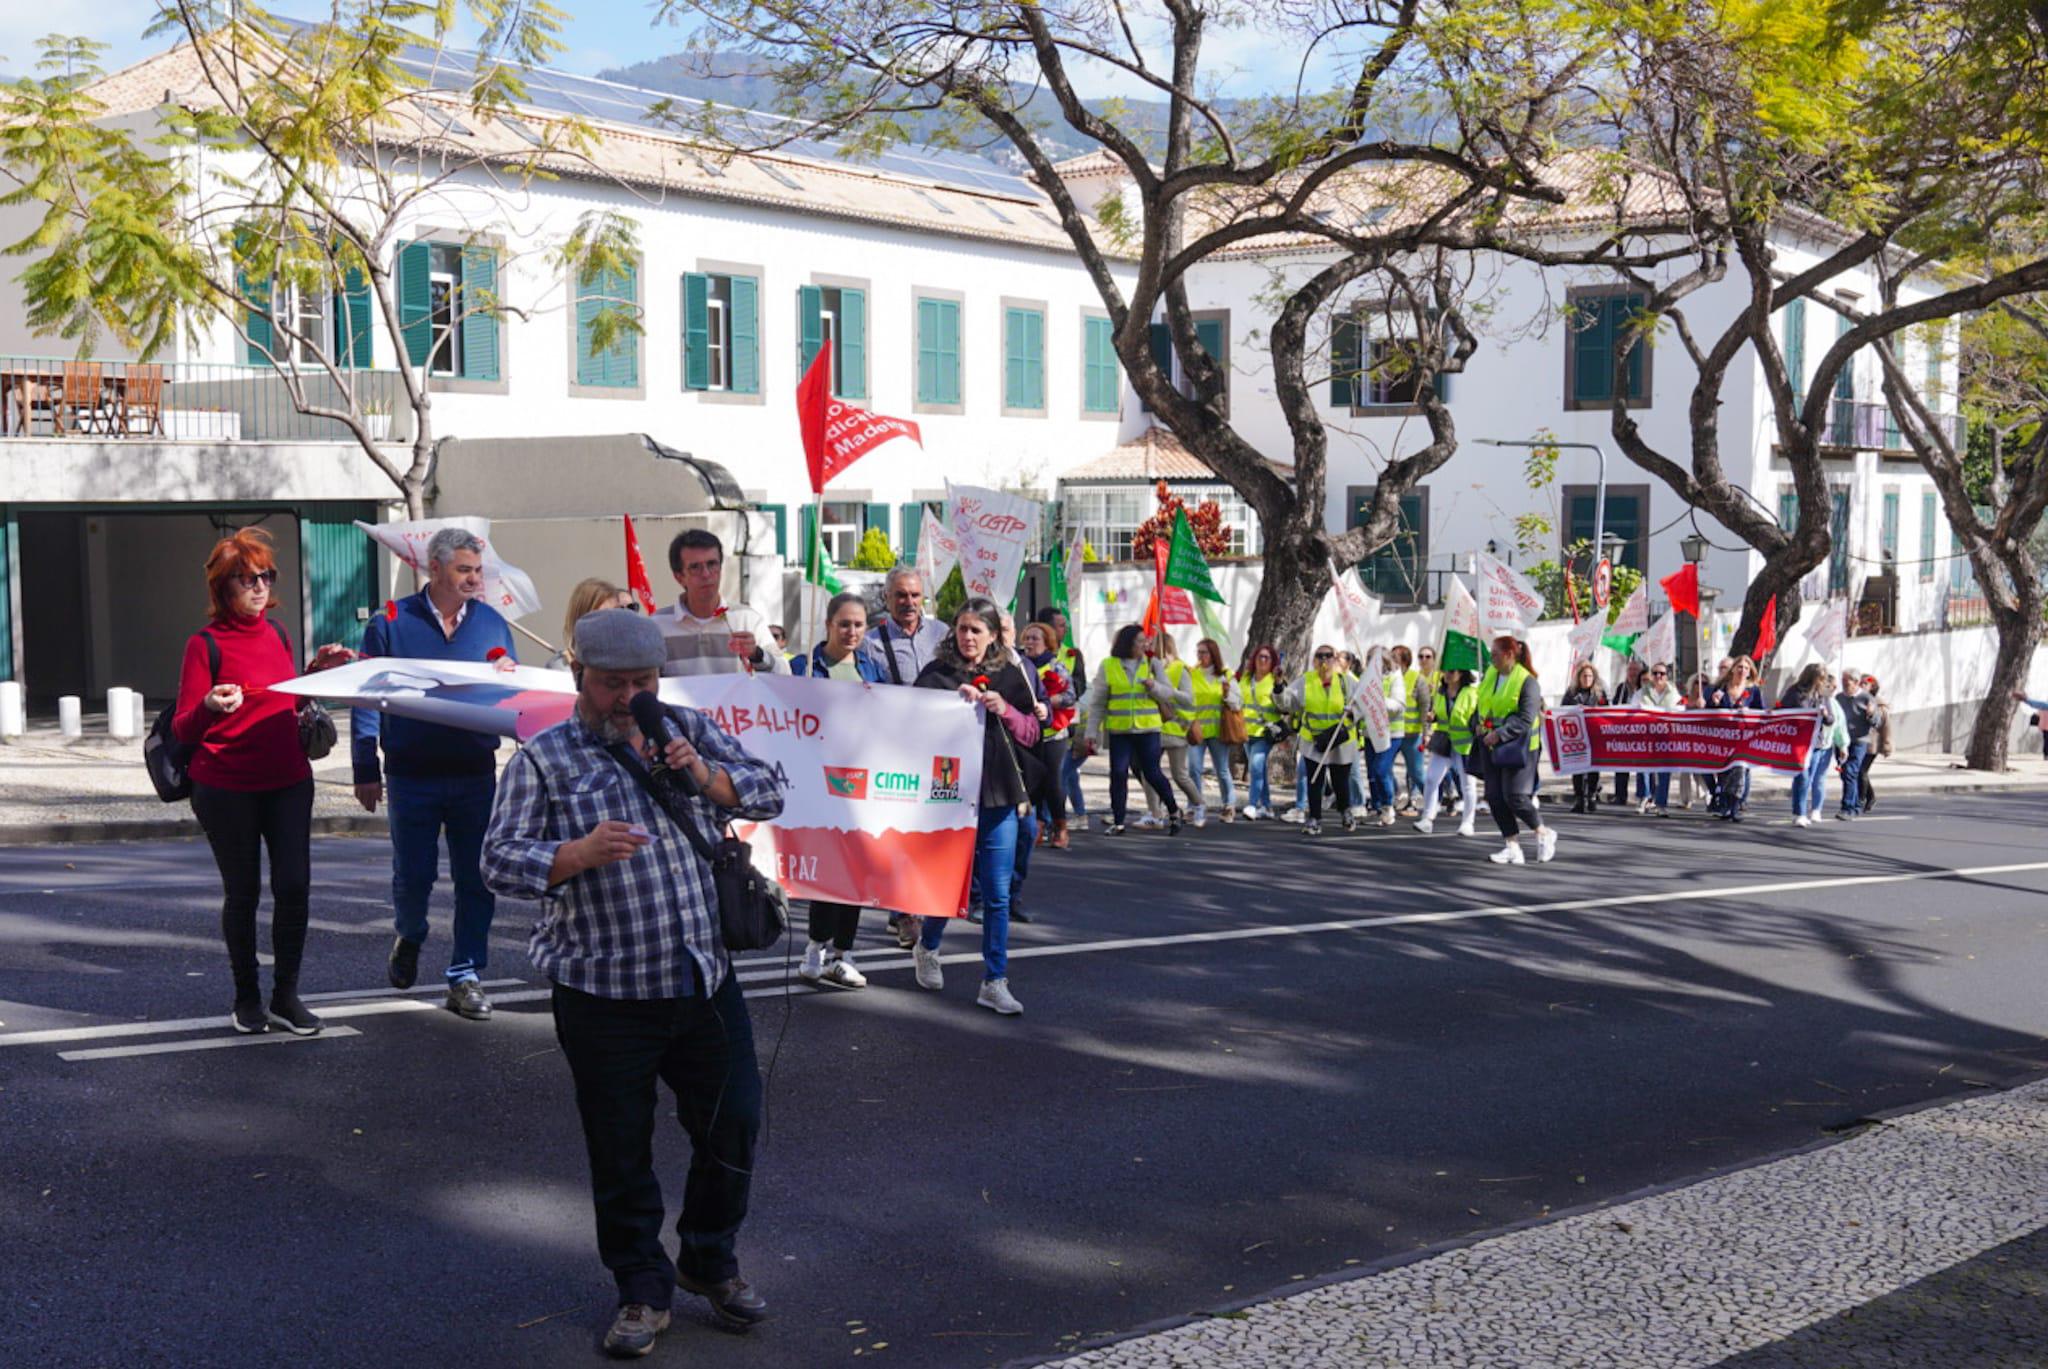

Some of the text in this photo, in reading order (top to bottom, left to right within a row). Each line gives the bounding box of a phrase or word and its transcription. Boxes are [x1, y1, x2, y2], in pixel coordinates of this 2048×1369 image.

[978, 512, 1026, 534] CGTP
[1600, 723, 1648, 735] SINDICATO
[1650, 723, 1669, 735] DOS
[1671, 723, 1742, 741] TRABALHADORES
[1606, 739, 1647, 753] PÚBLICAS
[1655, 740, 1691, 752] SOCIAIS
[1693, 742, 1707, 754] DO
[874, 771, 920, 790] CIMH
[789, 854, 818, 881] PAZ
